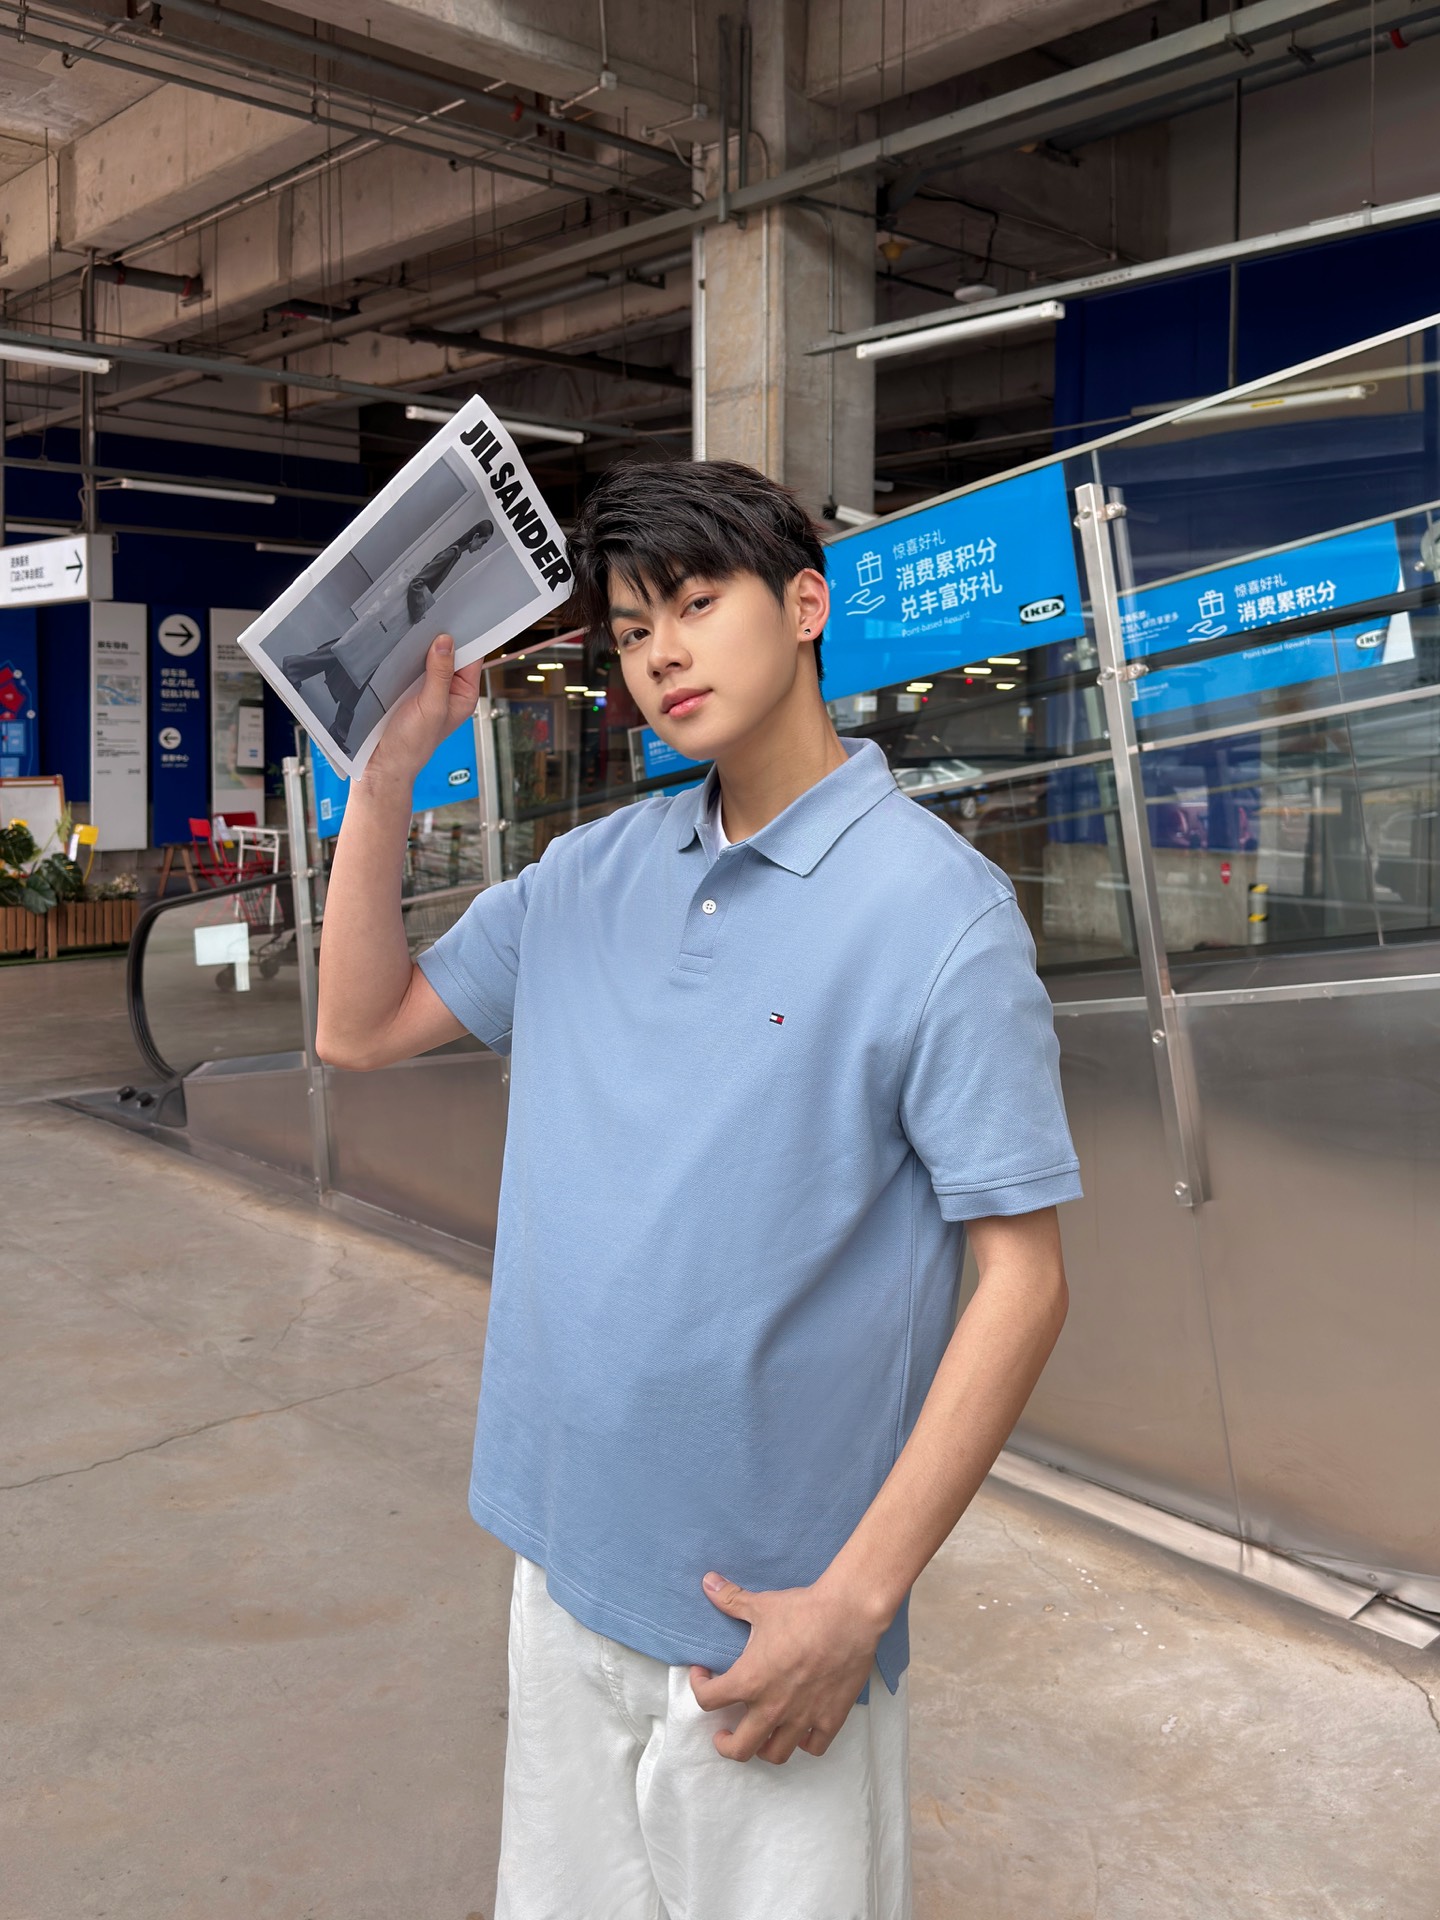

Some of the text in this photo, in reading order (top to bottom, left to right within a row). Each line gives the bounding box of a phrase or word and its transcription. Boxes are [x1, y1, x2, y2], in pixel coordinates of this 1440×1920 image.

[459, 419, 572, 592] JIL SANDER
[892, 528, 946, 561] 惊喜好礼
[895, 536, 998, 592] 消费累积分
[900, 568, 1003, 623] 兑丰富好礼
[1233, 573, 1288, 599] 惊喜好礼
[1236, 579, 1337, 623] 消费累积分
[901, 610, 971, 638] Point-based Reward
[1023, 601, 1062, 619] IKEA
[1243, 637, 1311, 660] Point-based Reward
